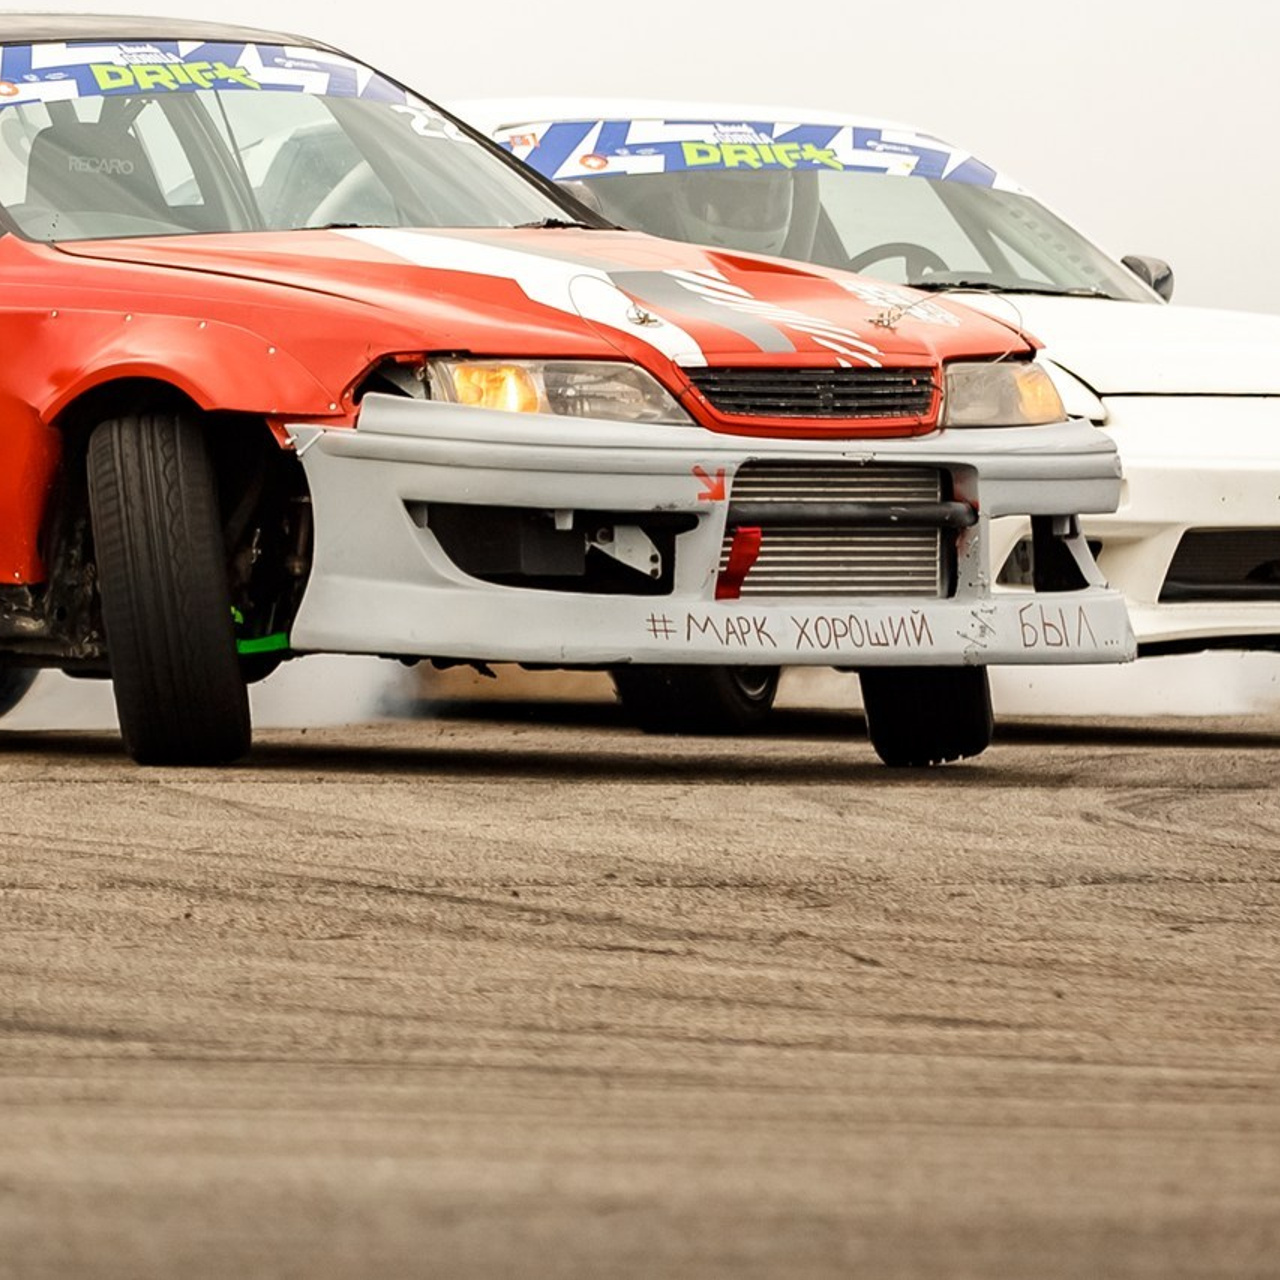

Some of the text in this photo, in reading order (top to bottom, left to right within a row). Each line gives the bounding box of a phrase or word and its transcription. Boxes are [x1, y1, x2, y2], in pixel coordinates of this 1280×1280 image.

[89, 61, 262, 90] DRIFT
[68, 156, 134, 175] RECARO
[681, 142, 844, 171] DRIFT
[791, 609, 934, 649] ХОРОШИЙ
